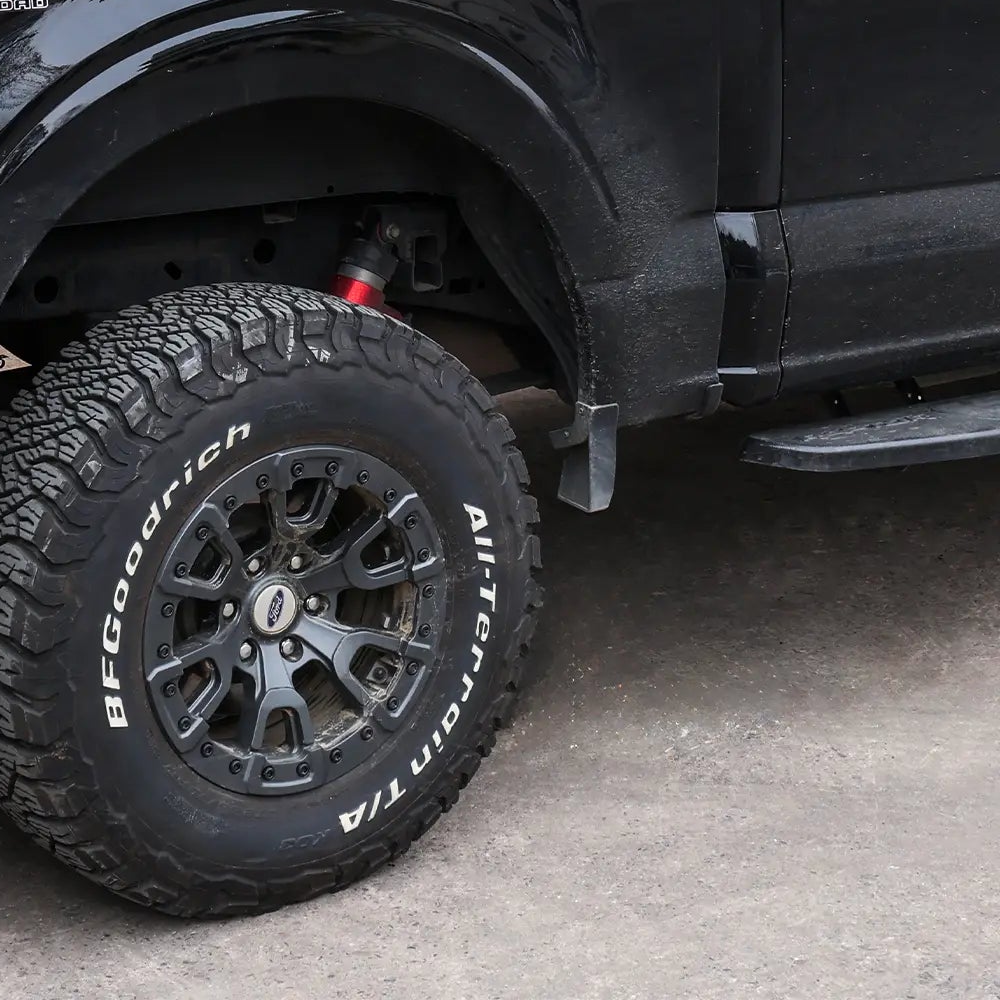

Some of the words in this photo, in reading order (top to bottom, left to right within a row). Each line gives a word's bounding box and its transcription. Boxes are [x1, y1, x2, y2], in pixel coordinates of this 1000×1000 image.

[101, 420, 251, 729] BFGoodrich
[268, 595, 283, 623] Ford
[409, 502, 496, 776] All-Terrain
[337, 776, 407, 835] T/A
